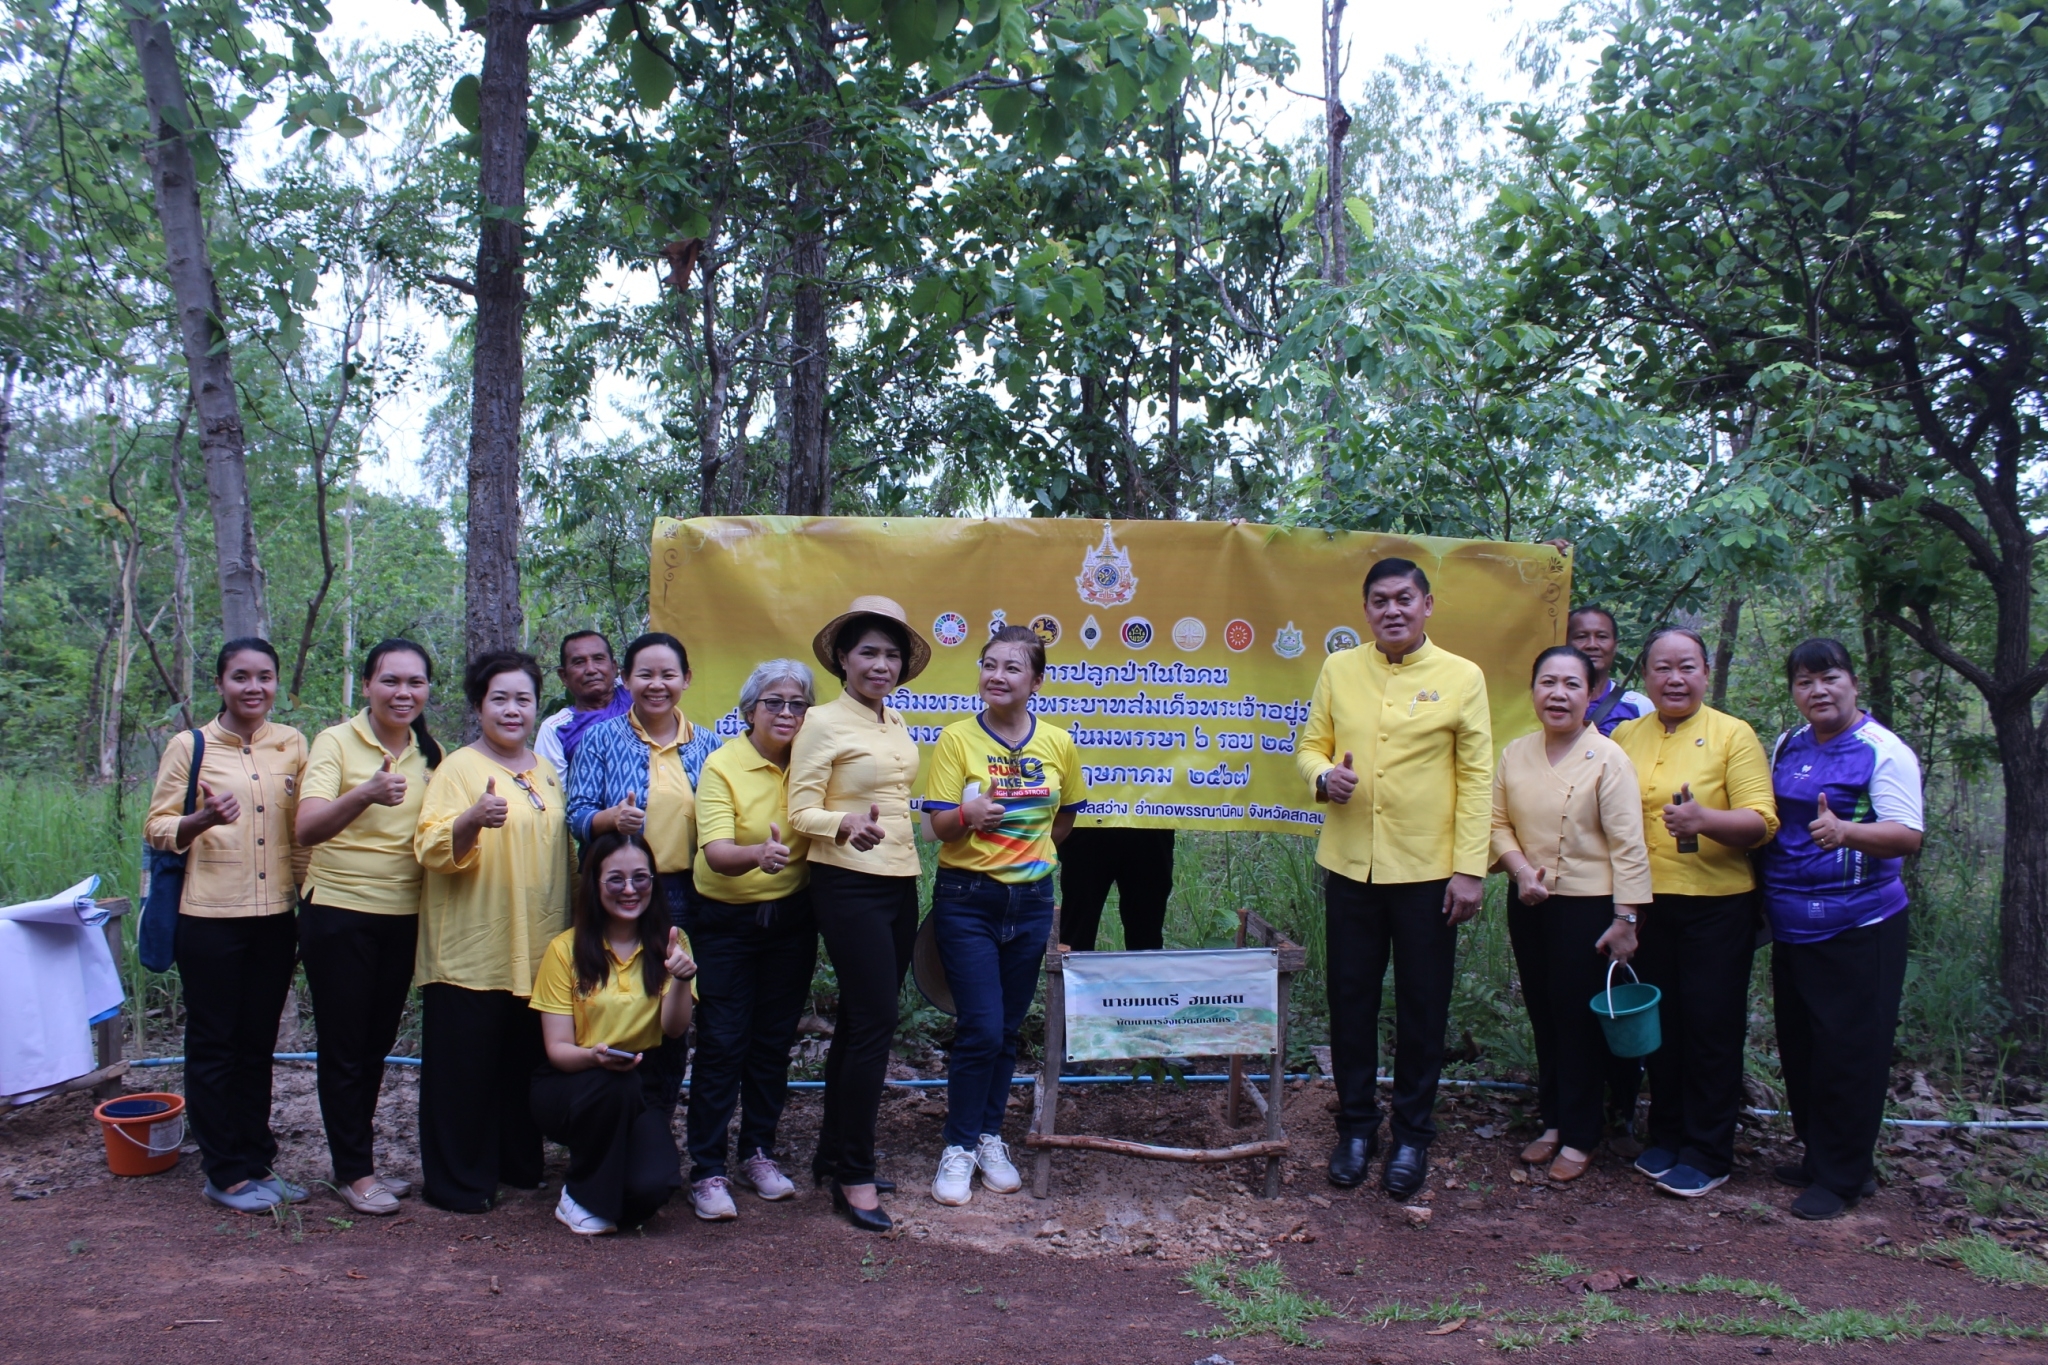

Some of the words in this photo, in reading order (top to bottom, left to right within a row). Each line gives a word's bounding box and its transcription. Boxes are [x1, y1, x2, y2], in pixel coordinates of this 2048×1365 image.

[1217, 733, 1254, 750] รอบ
[1020, 757, 1046, 787] 9
[1081, 765, 1173, 787] ฤษภาคม
[1025, 788, 1048, 796] STROKE
